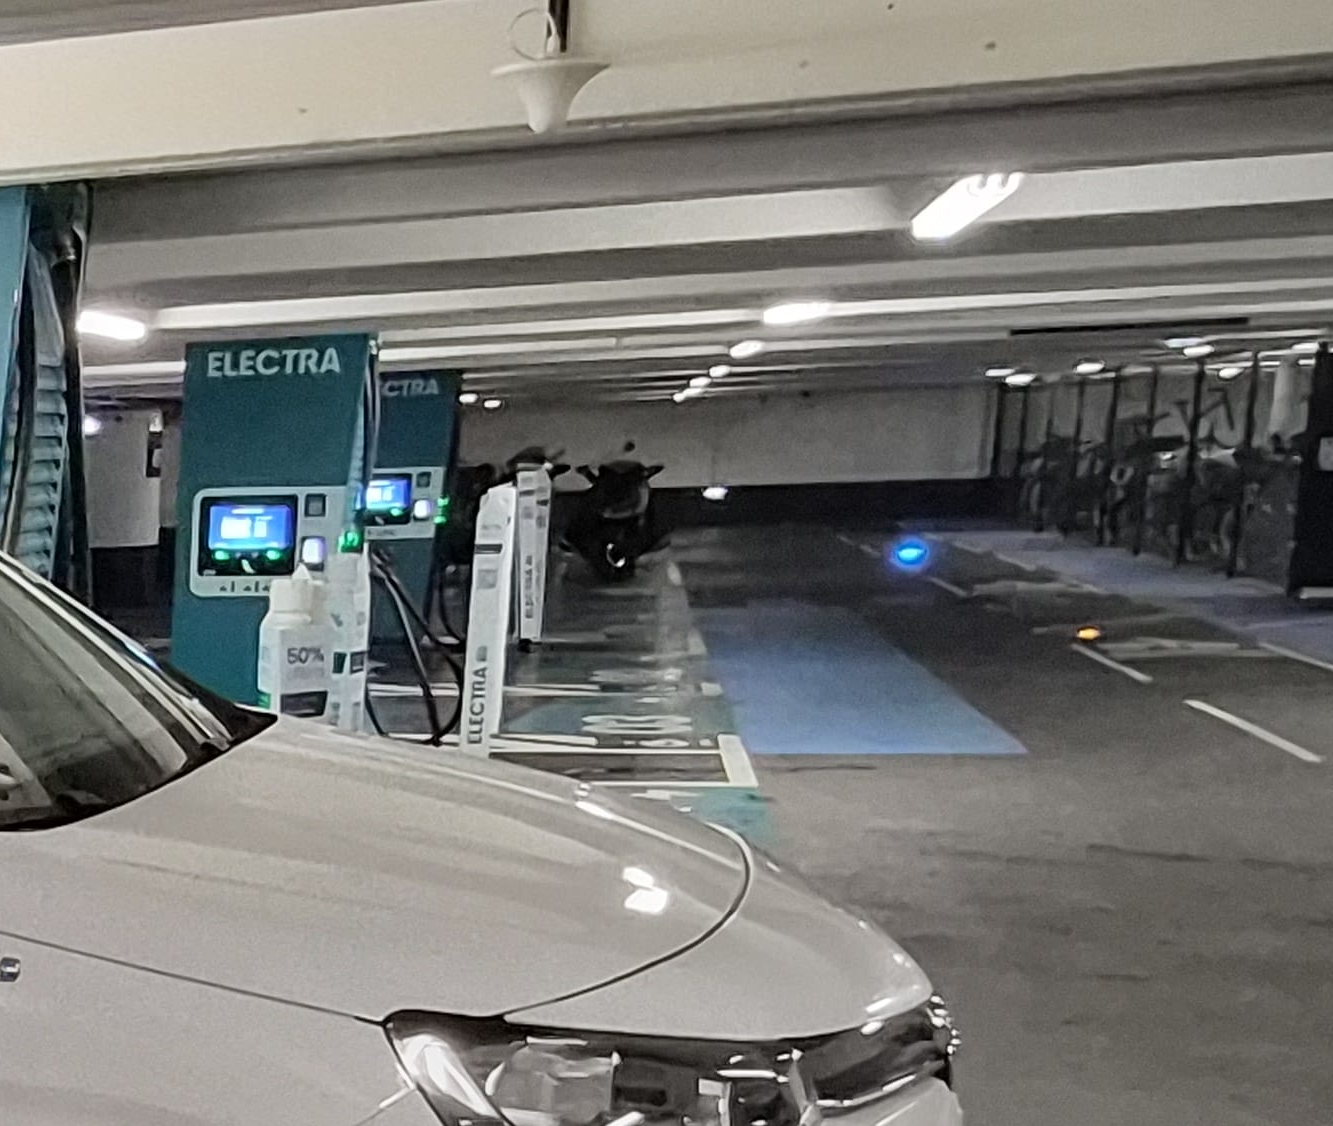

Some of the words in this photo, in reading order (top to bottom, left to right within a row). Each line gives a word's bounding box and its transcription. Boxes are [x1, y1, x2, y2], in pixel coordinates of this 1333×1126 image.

[207, 347, 341, 377] ELECTRA
[380, 378, 439, 397] CTRA
[287, 647, 325, 665] 50%
[467, 667, 488, 744] ELECTRA
